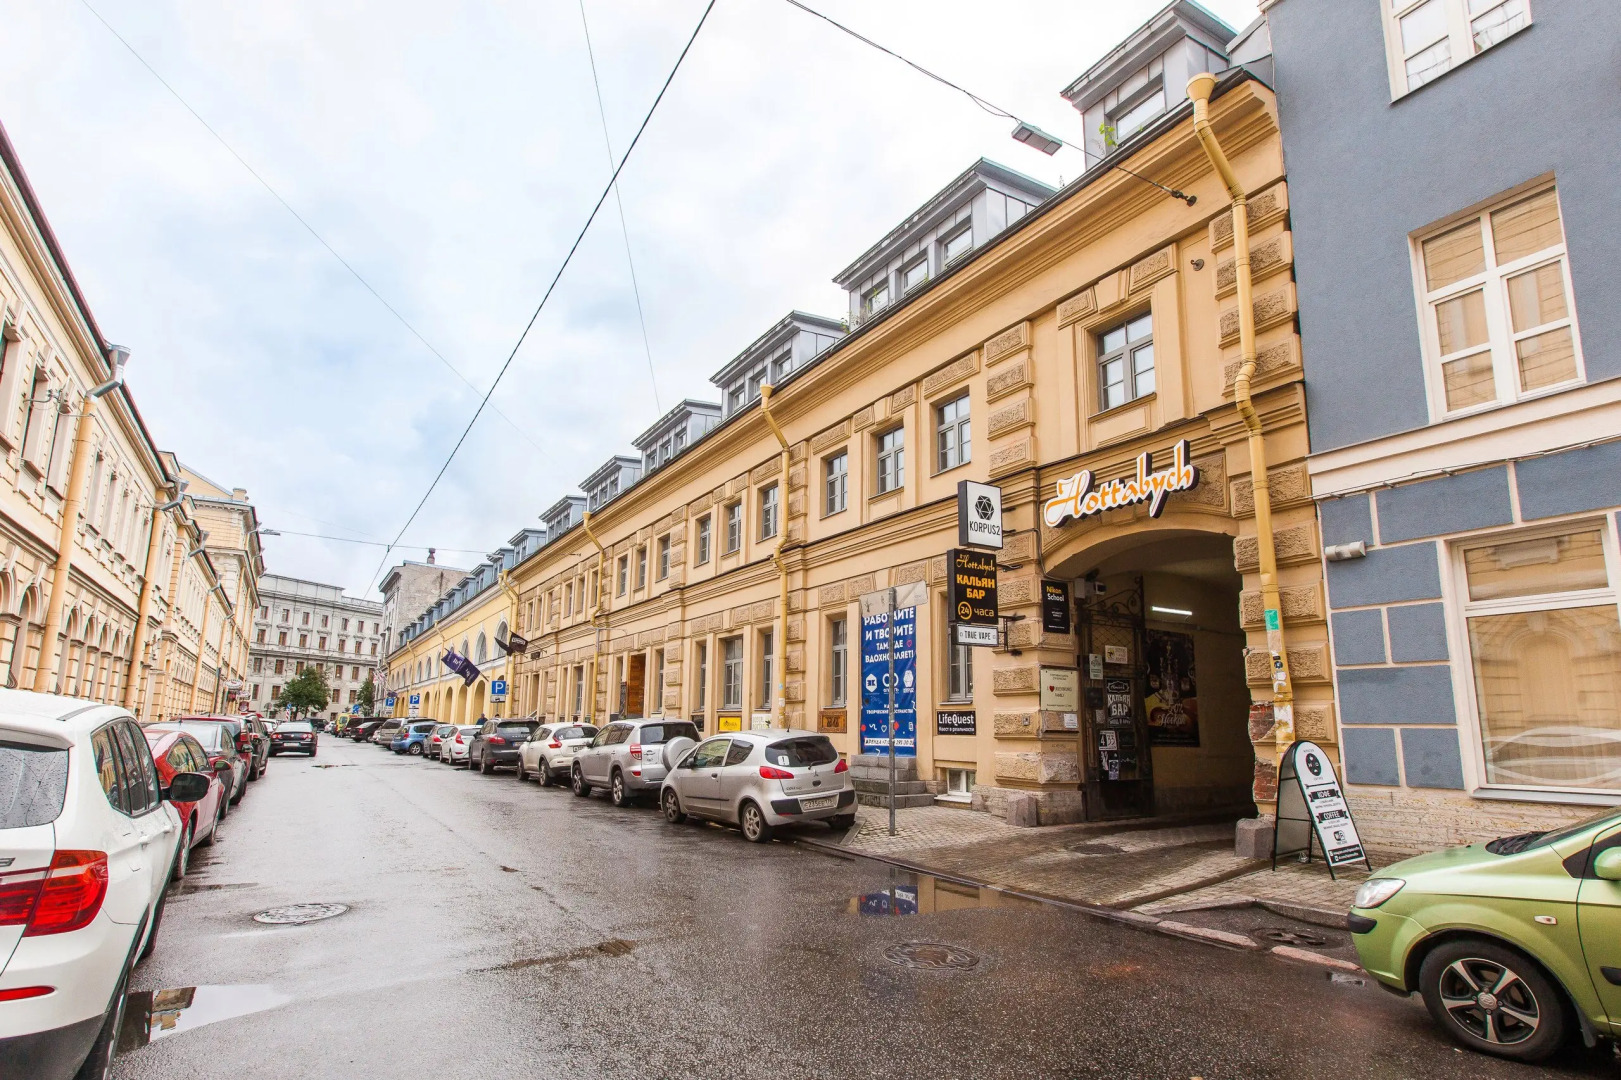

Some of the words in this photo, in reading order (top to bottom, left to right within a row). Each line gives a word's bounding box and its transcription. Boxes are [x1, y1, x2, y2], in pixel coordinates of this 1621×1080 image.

[1045, 440, 1194, 527] Hottabych
[969, 521, 1000, 536] KORPUS2
[956, 554, 995, 575] Hottabych
[957, 574, 995, 588] КАЛЬЯН
[967, 588, 985, 599] БАР
[1047, 593, 1065, 602] School
[960, 606, 970, 615] 24
[974, 608, 994, 617] часа
[865, 631, 873, 641] И
[874, 624, 913, 639] ТВОИТЕ
[965, 631, 977, 640] TRUE
[979, 632, 991, 641] VAPE
[496, 682, 504, 694] P
[1111, 703, 1129, 716] БАР
[938, 713, 975, 726] LifeQuest
[1323, 811, 1341, 820] COFFEE
